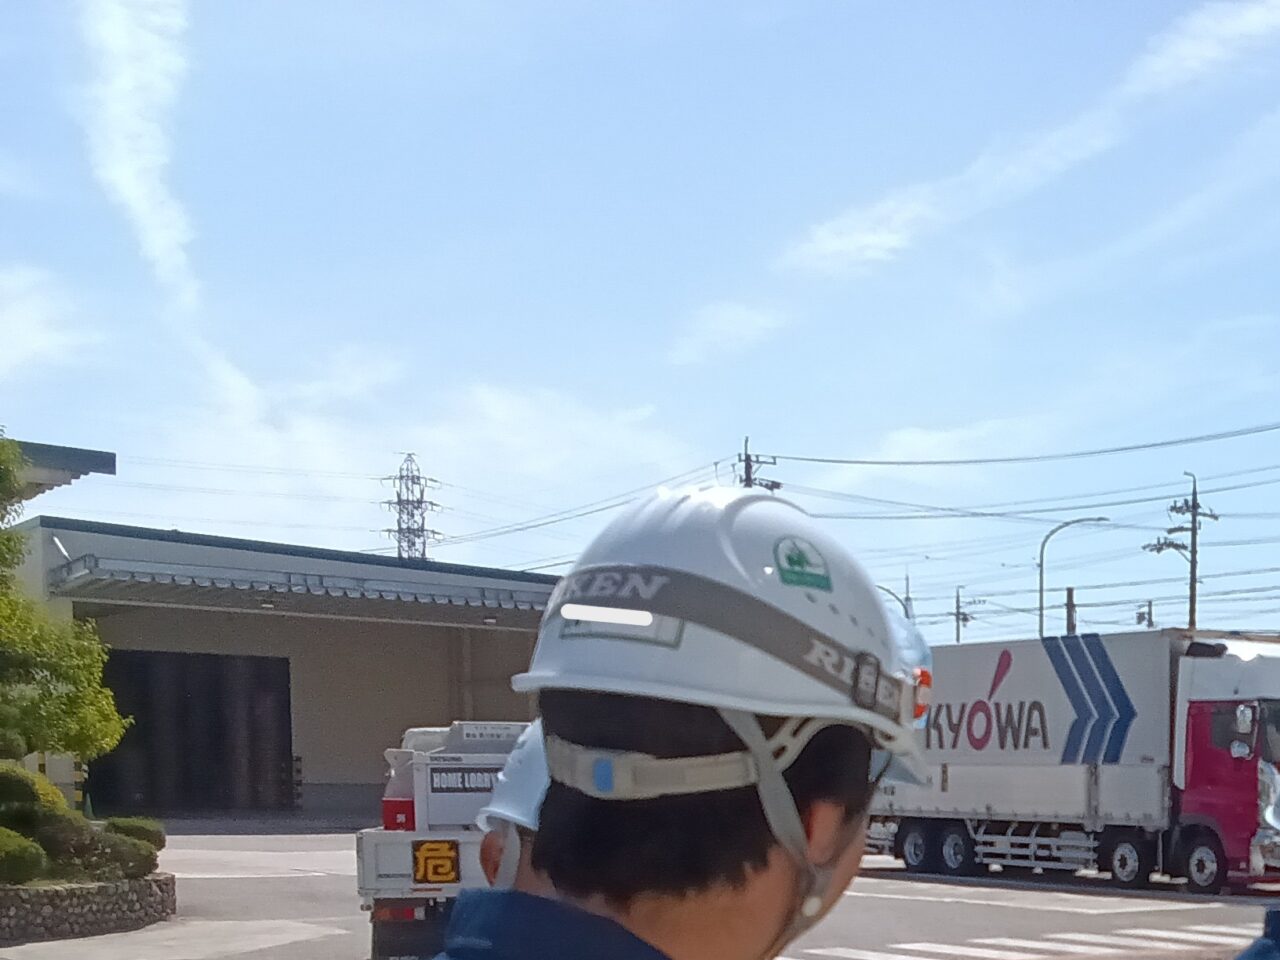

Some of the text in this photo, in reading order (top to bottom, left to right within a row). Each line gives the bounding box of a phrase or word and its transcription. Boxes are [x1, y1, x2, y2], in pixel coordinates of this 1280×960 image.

[925, 695, 1051, 752] KYOWA
[432, 772, 463, 788] HOME
[415, 842, 457, 883] 危
